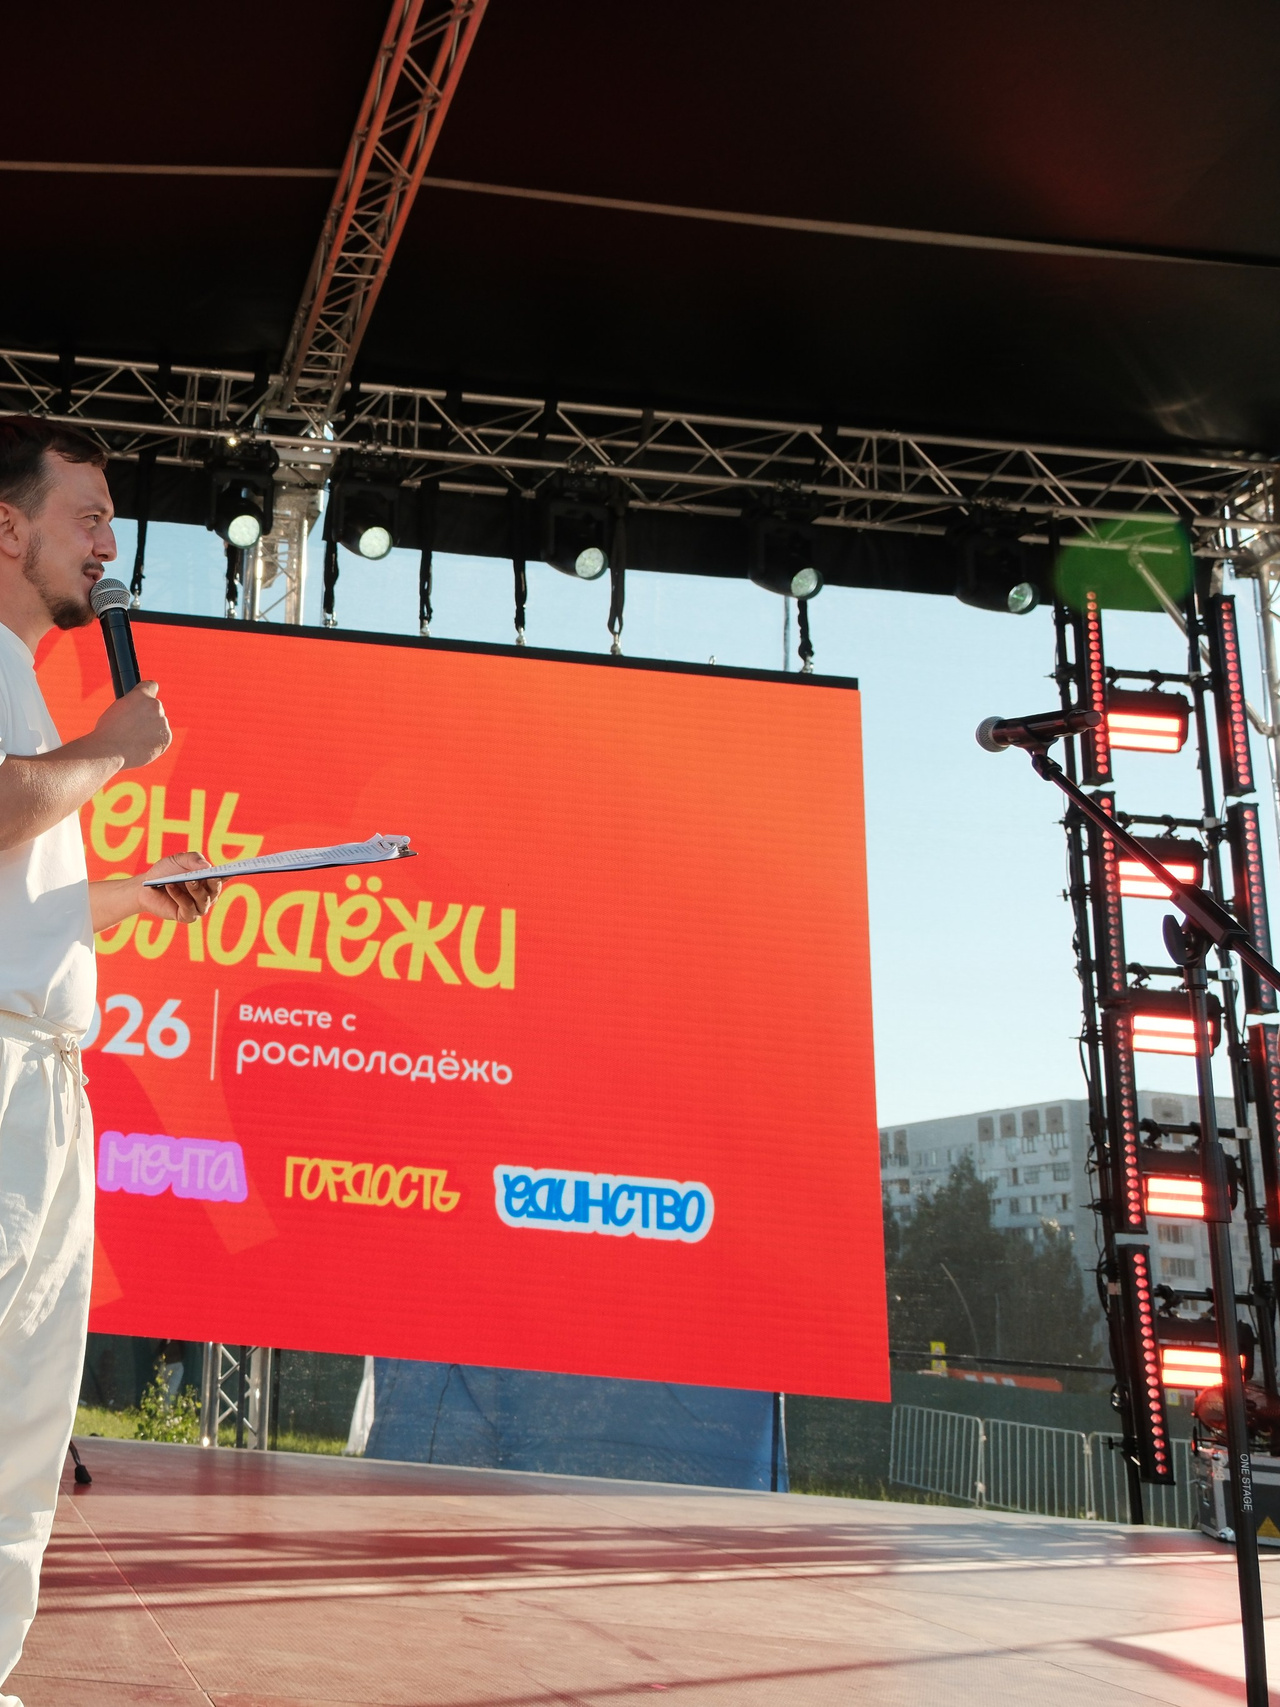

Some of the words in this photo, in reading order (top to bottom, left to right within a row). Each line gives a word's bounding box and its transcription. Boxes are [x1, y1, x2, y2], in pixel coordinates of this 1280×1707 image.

[78, 781, 264, 865] ень
[81, 993, 191, 1060] 26
[238, 1003, 332, 1030] вместе
[341, 1012, 357, 1031] с
[236, 1038, 513, 1085] росмолодёжь
[1240, 1453, 1250, 1475] ONE
[1241, 1477, 1253, 1511] STAGE
